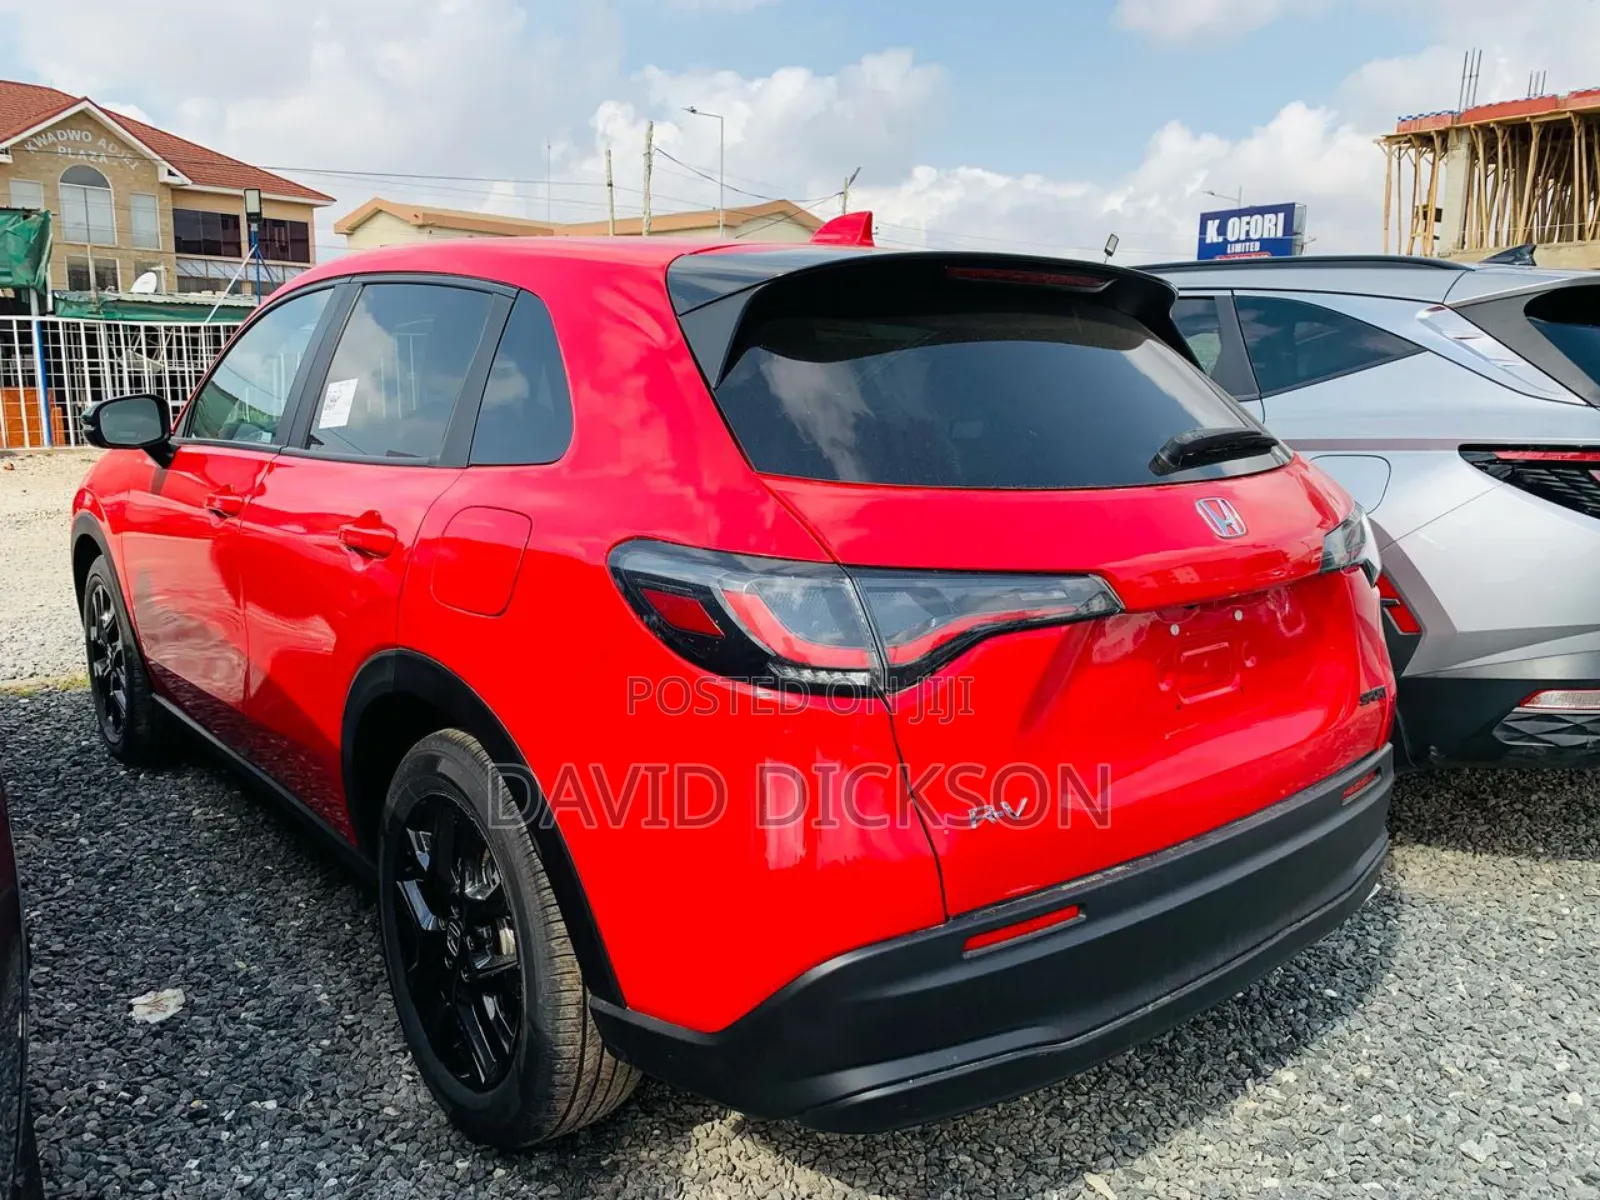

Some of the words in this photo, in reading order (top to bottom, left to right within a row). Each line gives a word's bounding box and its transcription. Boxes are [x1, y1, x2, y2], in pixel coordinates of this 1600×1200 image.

[25, 129, 92, 154] KWADWO
[57, 145, 109, 165] PLAZA
[1205, 219, 1223, 244] K.
[1226, 212, 1284, 241] OFORI
[1226, 241, 1260, 254] LIMITED
